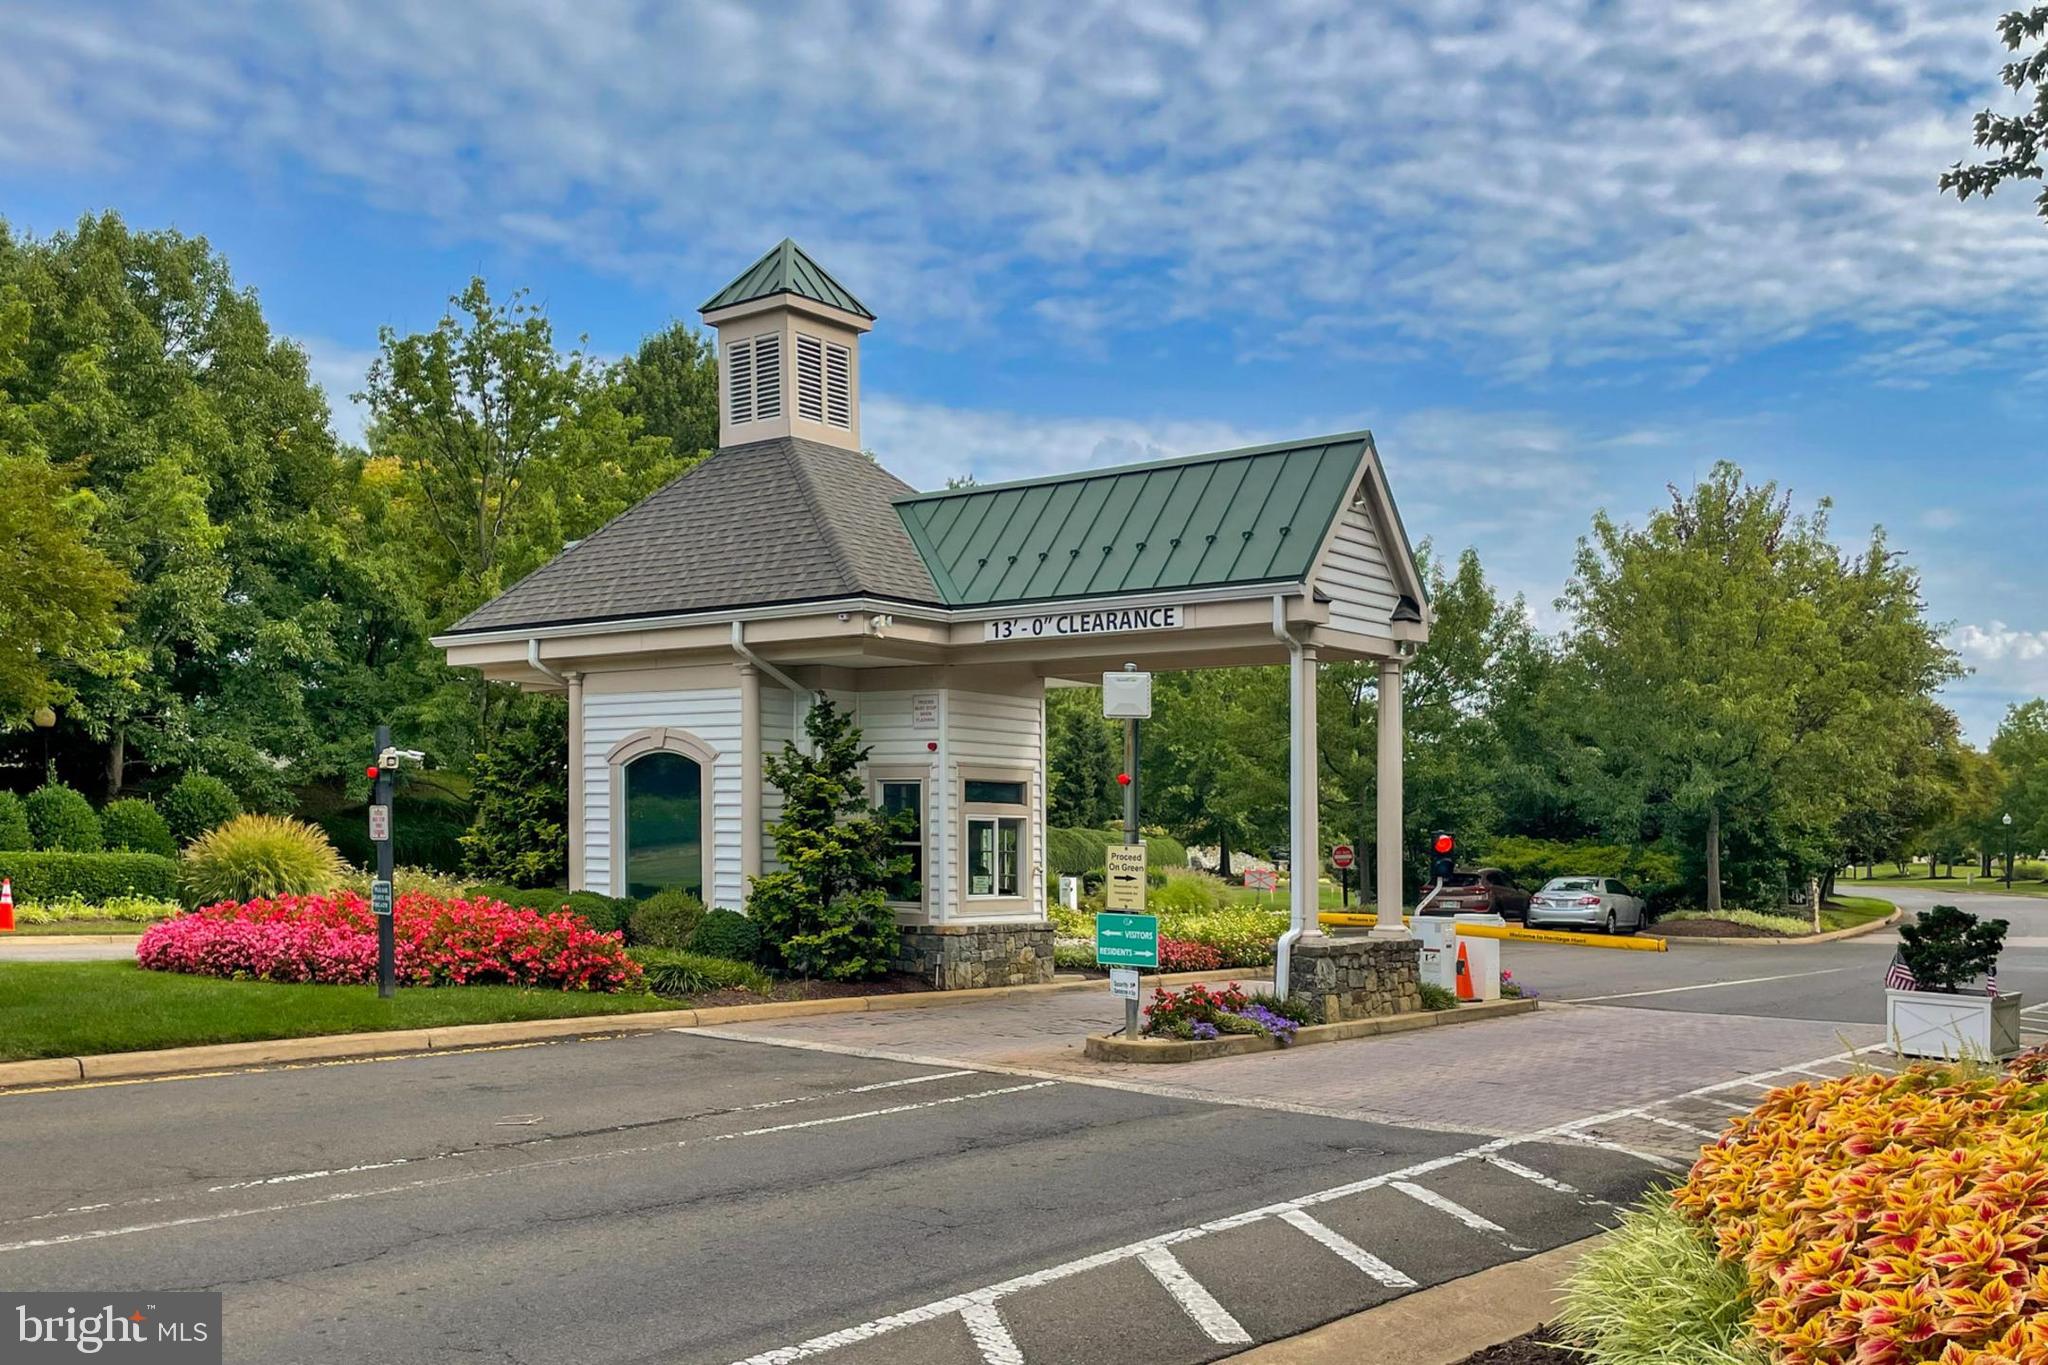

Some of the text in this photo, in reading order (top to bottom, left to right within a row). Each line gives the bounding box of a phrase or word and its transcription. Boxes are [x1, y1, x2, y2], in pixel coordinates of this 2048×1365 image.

[1056, 607, 1175, 634] CLEARANCE
[1111, 852, 1142, 862] Proceed
[1108, 862, 1145, 872] On Green
[1124, 930, 1153, 940] VISITORS
[1099, 947, 1133, 957] RESIDENTS
